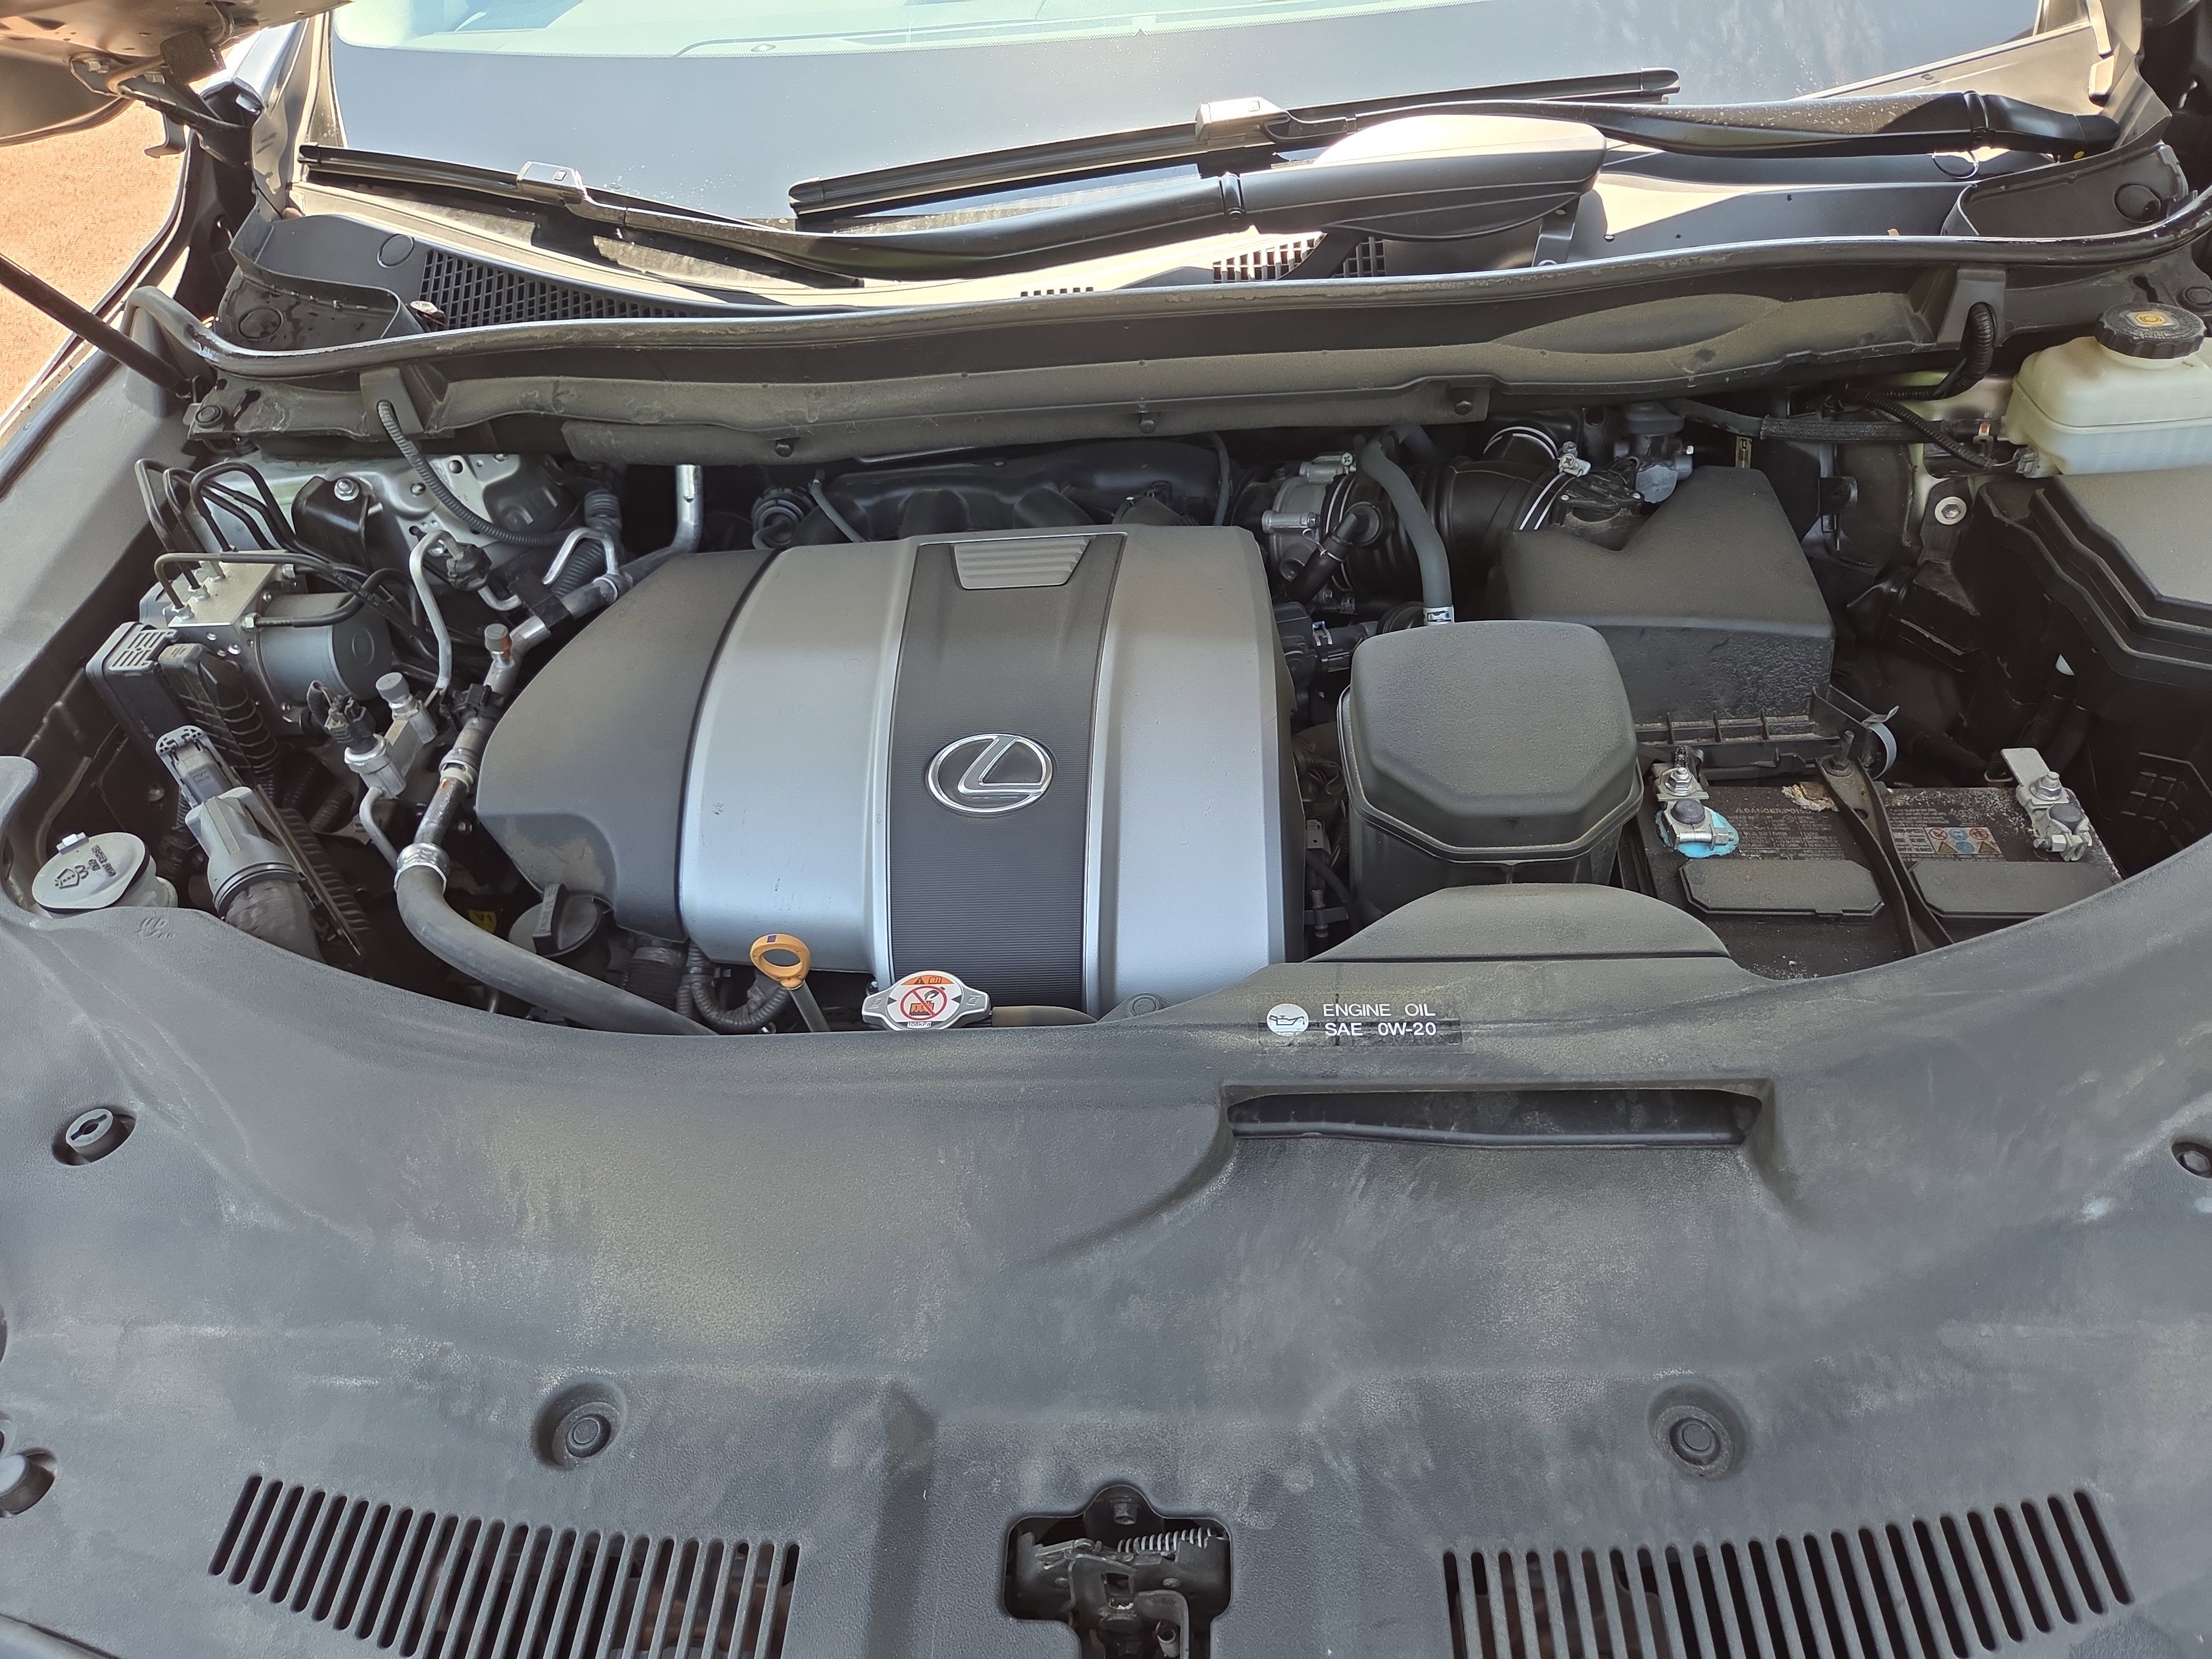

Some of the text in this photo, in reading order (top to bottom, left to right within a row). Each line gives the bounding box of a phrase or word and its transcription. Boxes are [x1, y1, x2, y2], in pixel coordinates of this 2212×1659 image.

[1323, 1003, 1436, 1017] ENGINE OIL
[1324, 1021, 1437, 1037] SAE 0W-20
